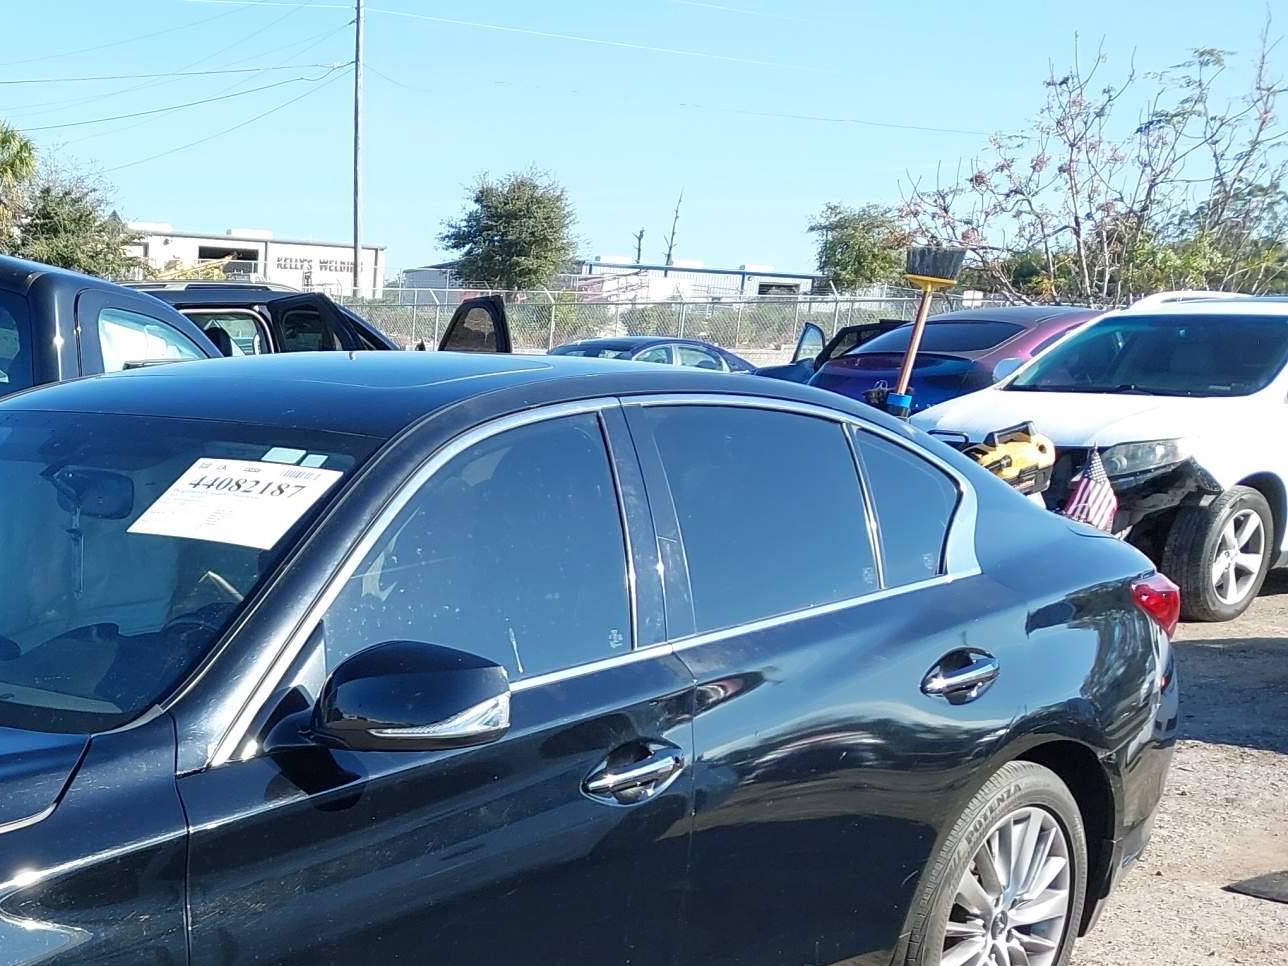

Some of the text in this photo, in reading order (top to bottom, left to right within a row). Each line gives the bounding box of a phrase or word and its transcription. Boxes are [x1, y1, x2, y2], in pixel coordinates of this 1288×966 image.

[276, 256, 312, 271] KELLY'S
[188, 474, 307, 498] 44082187
[964, 783, 1023, 846] POTENZA
